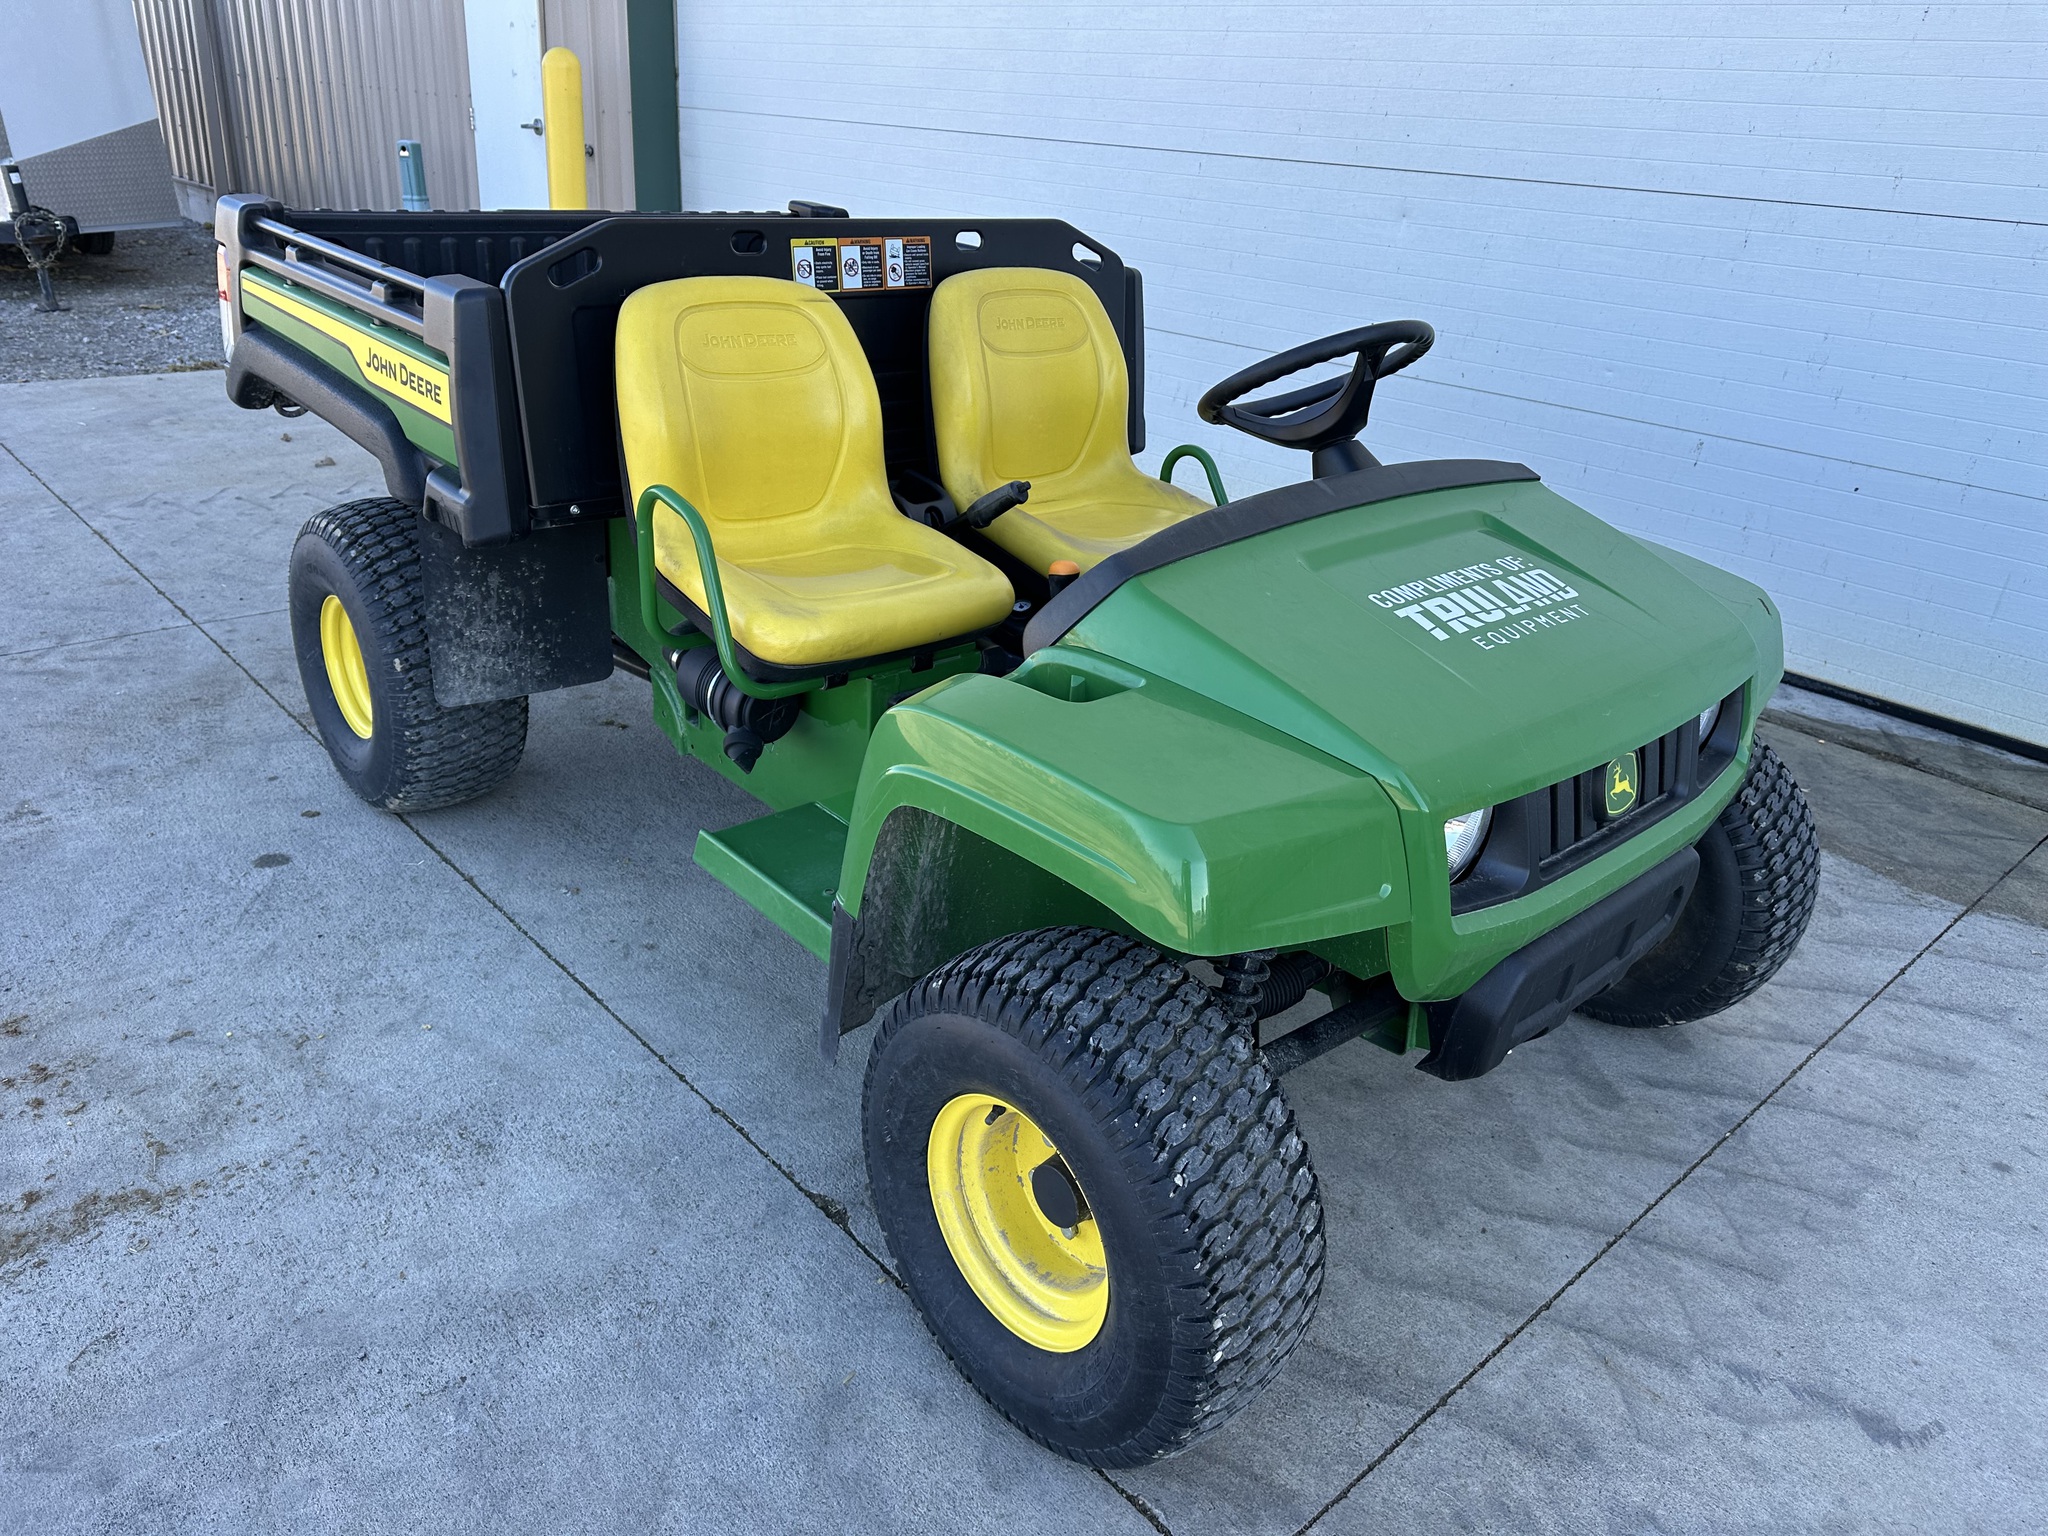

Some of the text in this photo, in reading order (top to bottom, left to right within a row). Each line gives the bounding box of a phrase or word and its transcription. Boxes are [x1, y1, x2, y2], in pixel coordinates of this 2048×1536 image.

[702, 331, 798, 349] JOHN DEERE
[995, 316, 1066, 331] JOHN DEERE
[366, 346, 442, 405] JOHN DEERE
[1367, 562, 1504, 609] COMPLIMENTS
[1393, 568, 1580, 642] TRULAND
[1471, 603, 1591, 651] EQUIPMENT
